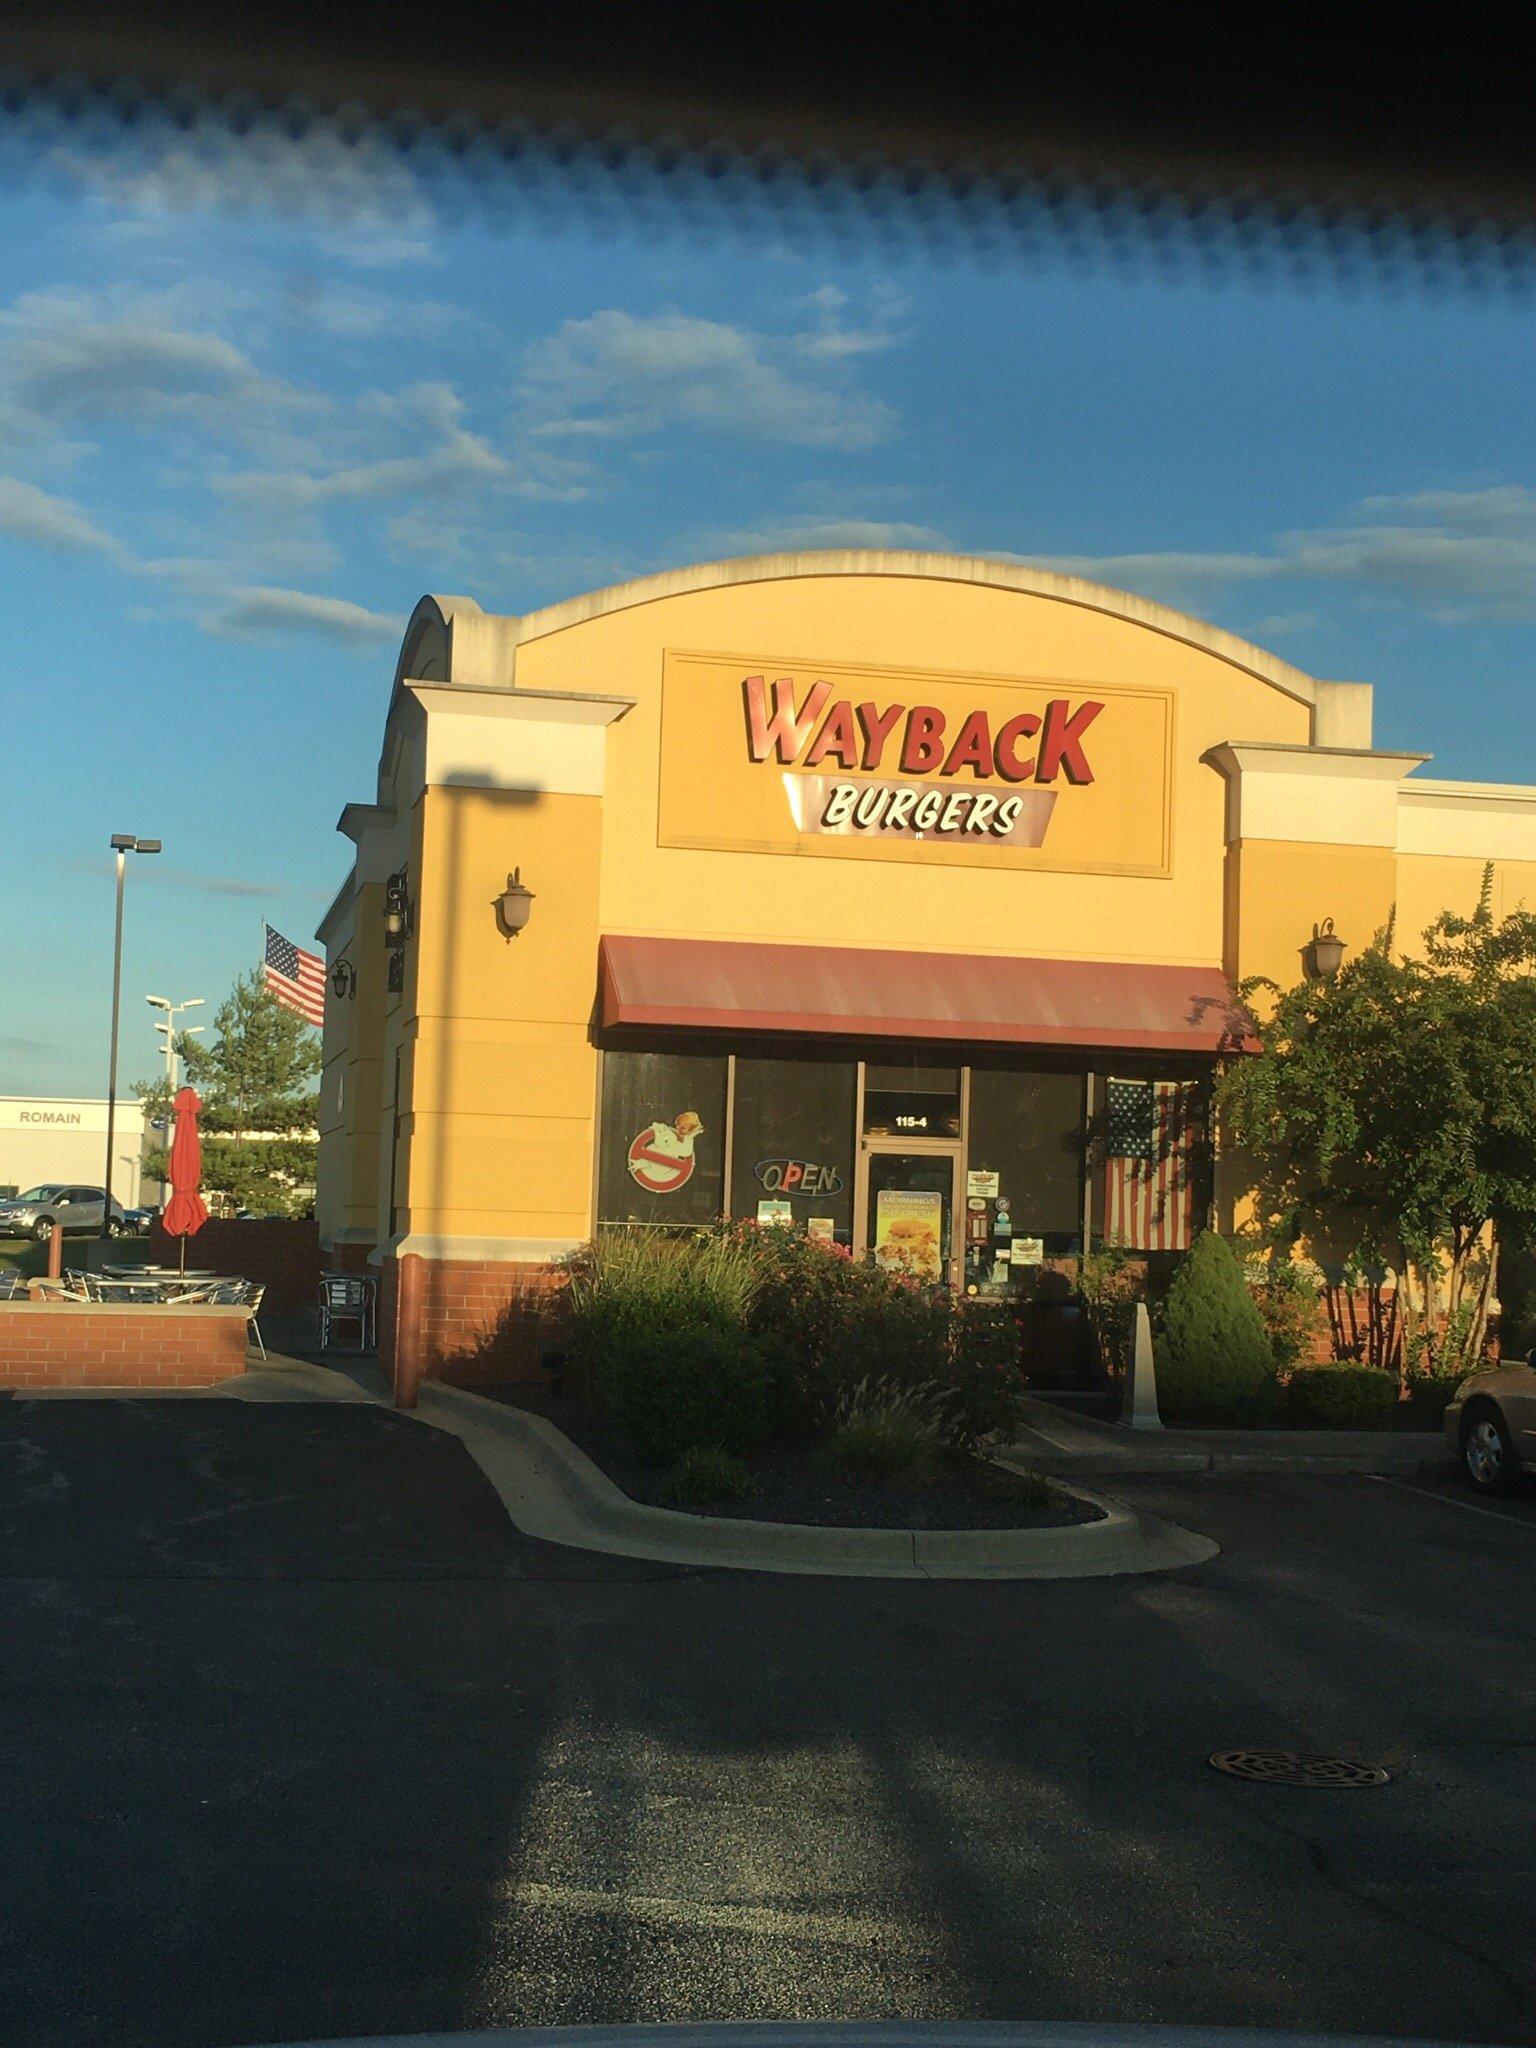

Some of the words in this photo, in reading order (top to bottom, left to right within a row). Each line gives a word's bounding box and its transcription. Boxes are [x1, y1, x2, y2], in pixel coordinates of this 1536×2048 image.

[741, 675, 1105, 786] WAYBACK
[821, 784, 1025, 838] BURGERS
[20, 1111, 81, 1124] ROMAIN
[895, 1115, 928, 1128] 115-4
[763, 1160, 837, 1192] OPEN
[883, 1195, 936, 1205] MORNINGS
